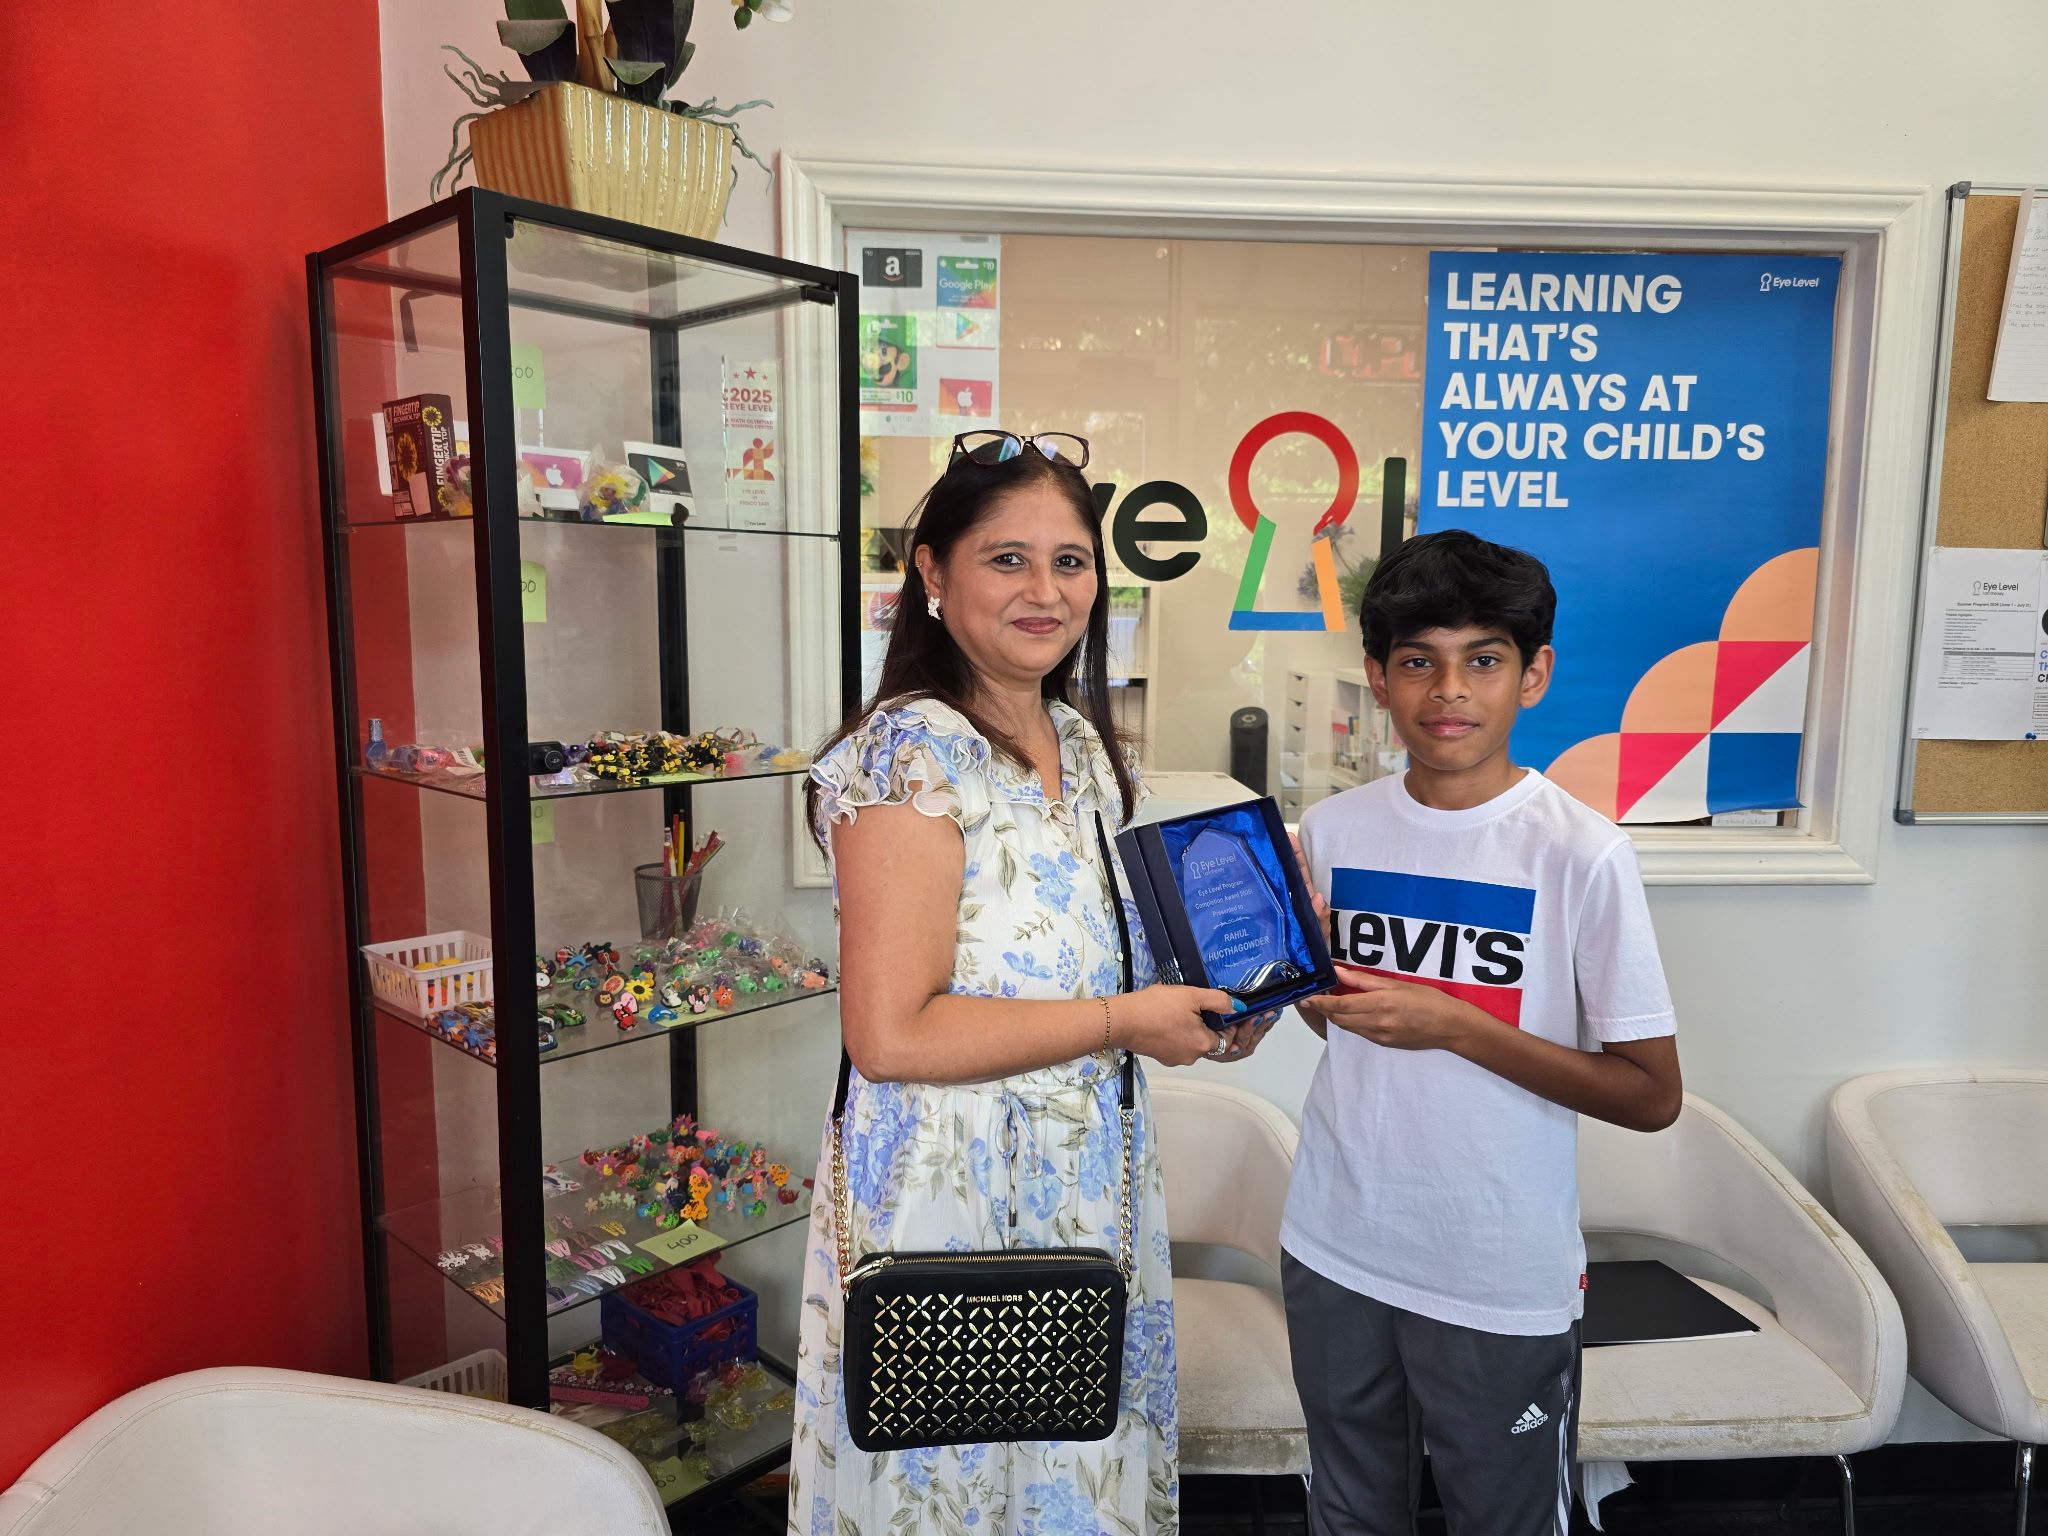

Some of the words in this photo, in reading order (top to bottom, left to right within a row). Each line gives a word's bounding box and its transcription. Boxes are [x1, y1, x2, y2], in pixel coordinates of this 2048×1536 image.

[939, 278, 973, 292] Google
[1773, 277, 1792, 289] Eye
[1792, 277, 1820, 288] Level
[1446, 271, 1684, 314] LEARNING
[1443, 321, 1599, 363] THAT'S
[730, 387, 773, 404] 2025
[1439, 372, 1627, 412] ALWAYS
[1638, 374, 1698, 412] AT
[730, 402, 746, 411] EYE
[748, 404, 774, 413] LEVEL
[441, 426, 449, 440] TOP
[1438, 421, 1569, 461] YOUR
[1582, 421, 1766, 462] CHILD'S
[430, 426, 445, 486] FINGERTIP
[1436, 470, 1570, 508] LEVEL
[1983, 582, 1998, 592] Eye
[1998, 582, 2019, 592] Level
[1200, 860, 1215, 872] Eye
[1215, 852, 1238, 867] Level
[1198, 889, 1209, 897] Eye
[1209, 884, 1222, 894] Level
[1222, 880, 1244, 890] Program
[1194, 896, 1224, 910] Completion
[1224, 891, 1240, 901] Award
[1223, 928, 1250, 943] RAHUL
[666, 1233, 699, 1250] 400
[966, 1294, 1001, 1304] MICHAEL
[1002, 1294, 1023, 1302] KORS
[1510, 1413, 1549, 1435] adidas
